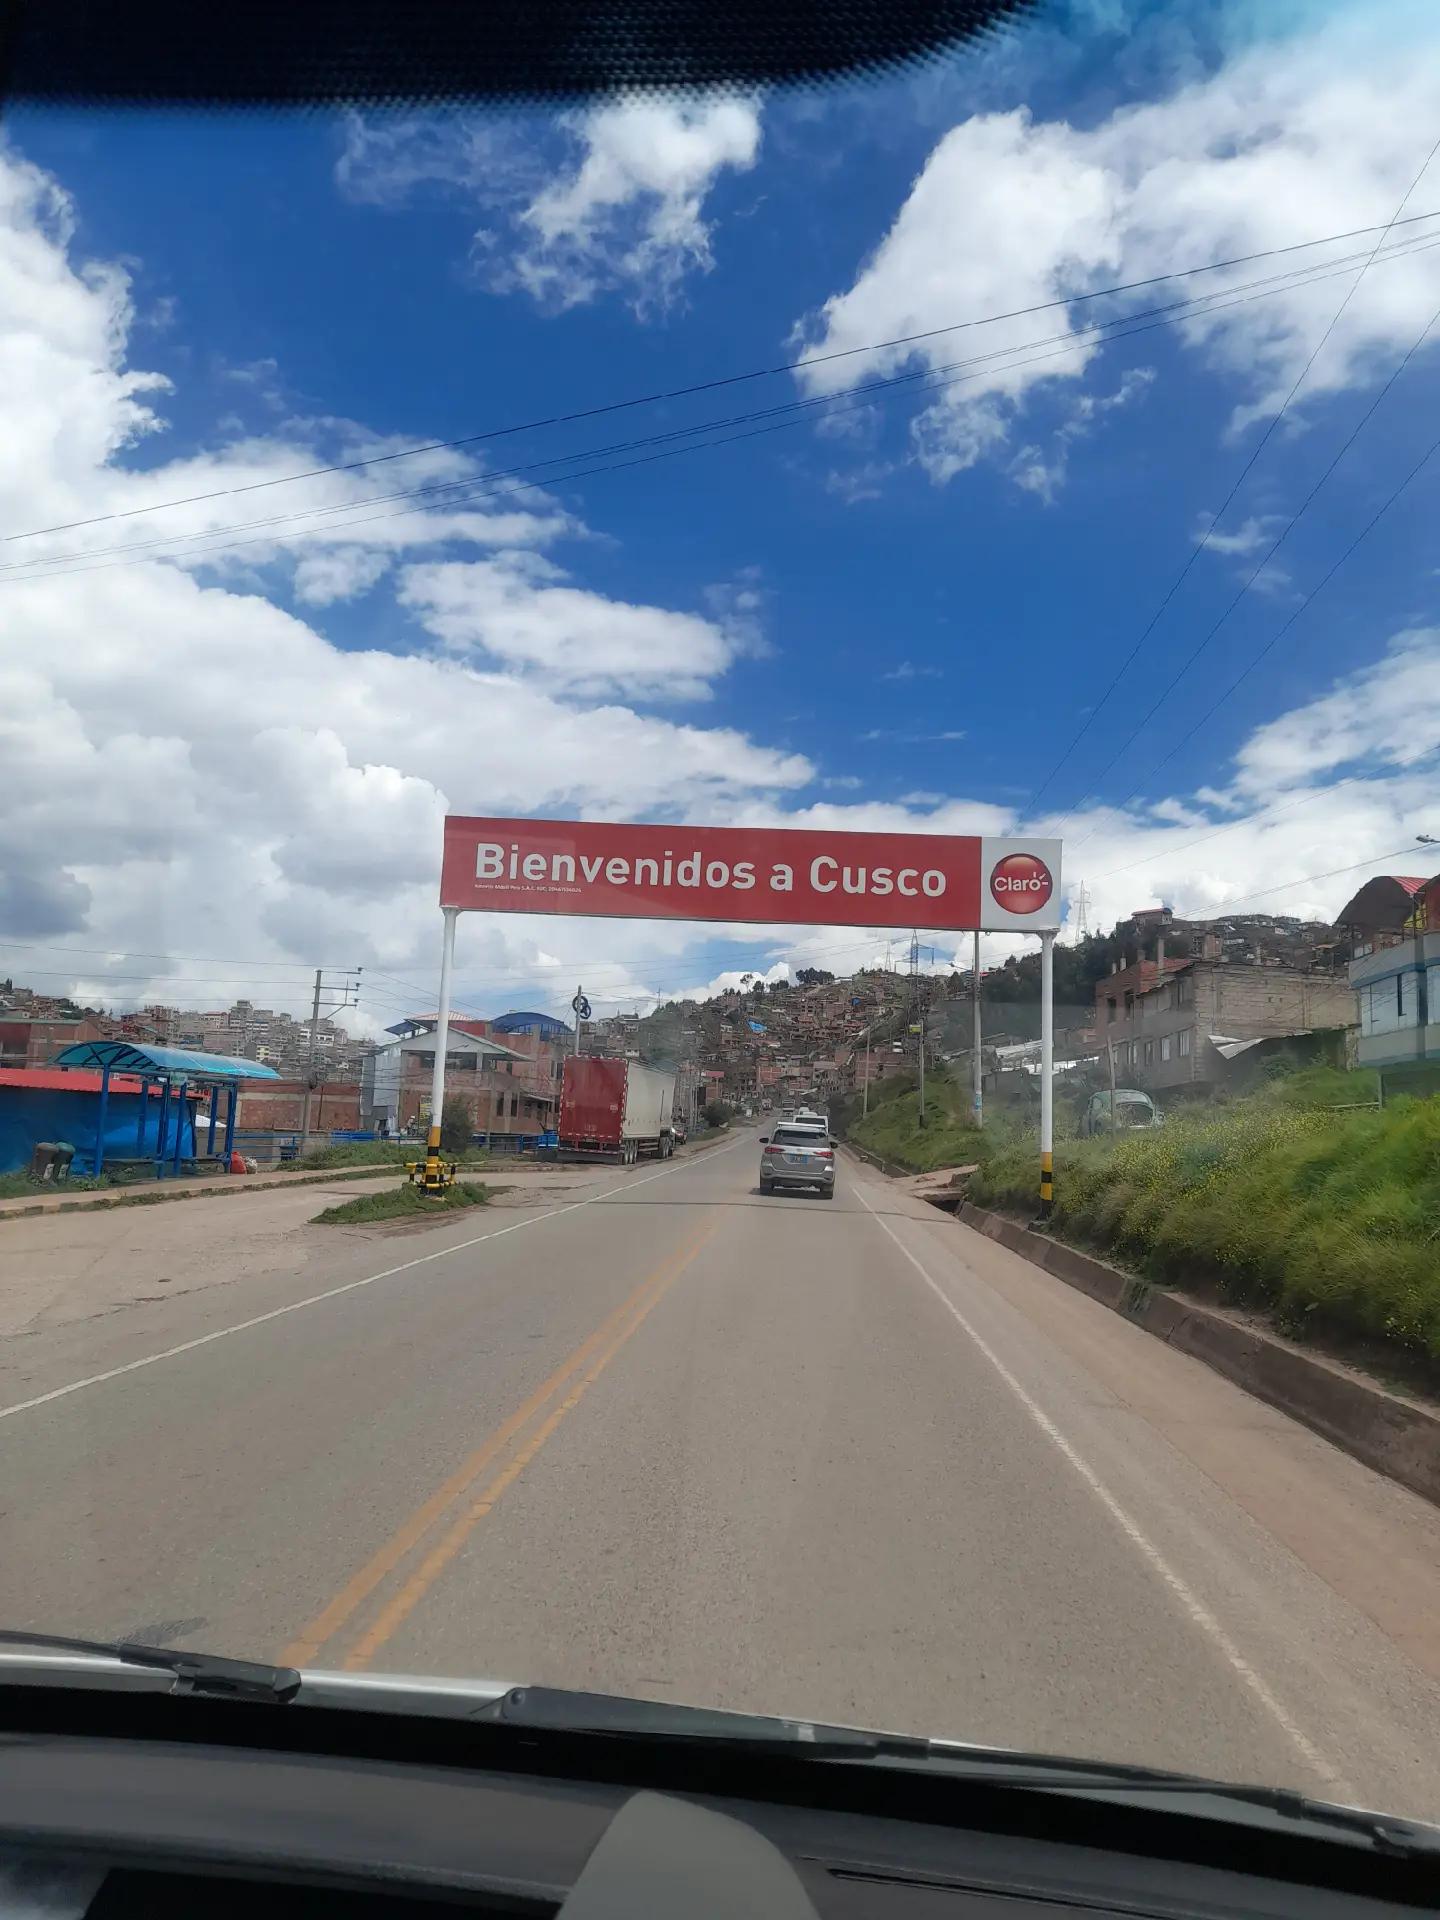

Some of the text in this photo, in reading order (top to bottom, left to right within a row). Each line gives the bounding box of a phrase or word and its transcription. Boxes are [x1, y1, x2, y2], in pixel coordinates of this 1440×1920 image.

[475, 842, 947, 897] Bienvenidos a Cusco
[994, 875, 1042, 891] Claro
